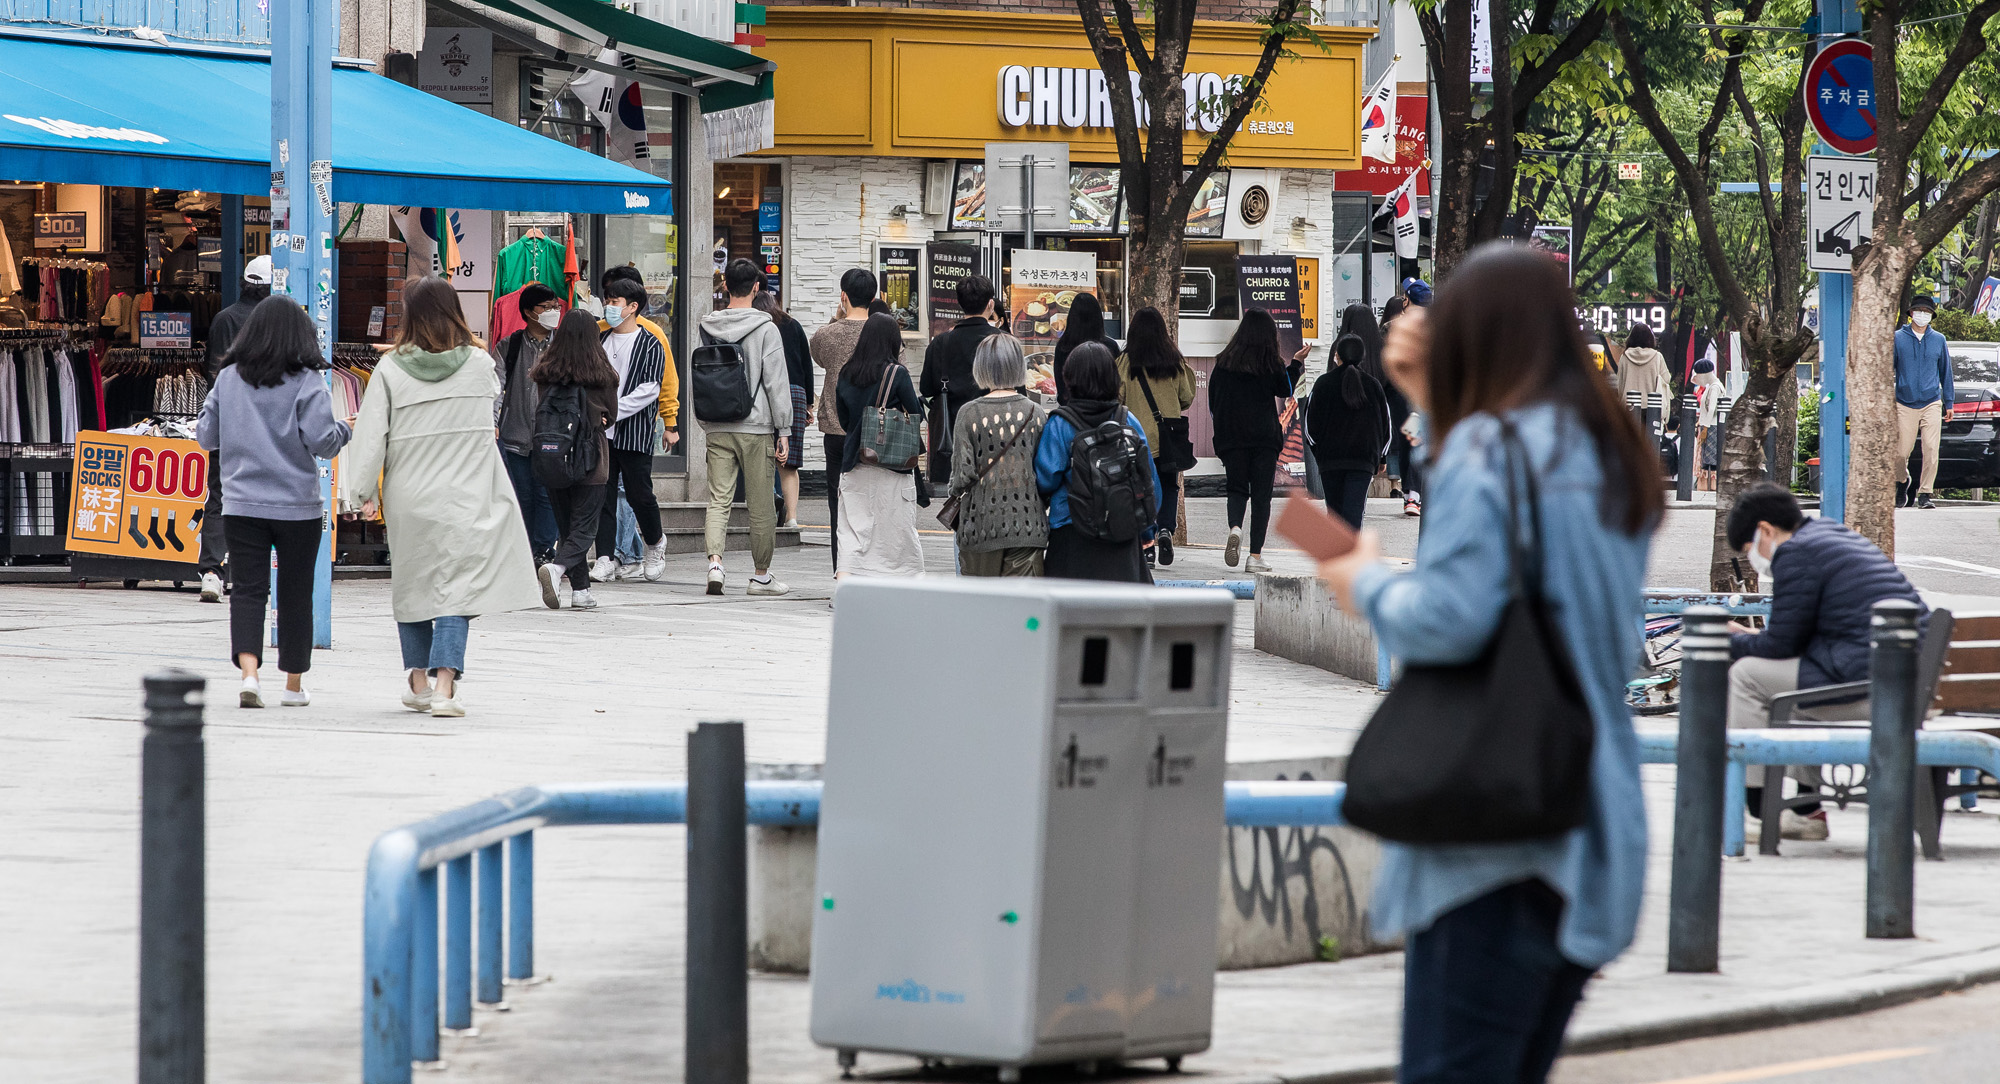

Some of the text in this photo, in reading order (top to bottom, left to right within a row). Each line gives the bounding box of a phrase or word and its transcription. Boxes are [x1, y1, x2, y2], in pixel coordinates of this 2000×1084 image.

[481, 76, 489, 84] 5F
[998, 64, 1244, 133] CHURR101
[1820, 88, 1876, 105] 주차금
[1248, 120, 1294, 136] 츄로원오원
[1815, 170, 1873, 204] 견인지
[933, 265, 972, 277] CHURRO &
[1019, 268, 1089, 282] 숙성돈까츠정식
[932, 278, 957, 290] ICE CR
[1246, 277, 1290, 287] CHURRO &
[1252, 291, 1286, 301] COFFEE
[83, 447, 124, 472] 양말
[80, 471, 121, 488] SOCKS
[128, 446, 206, 499] 600
[76, 508, 118, 534] 靴下
